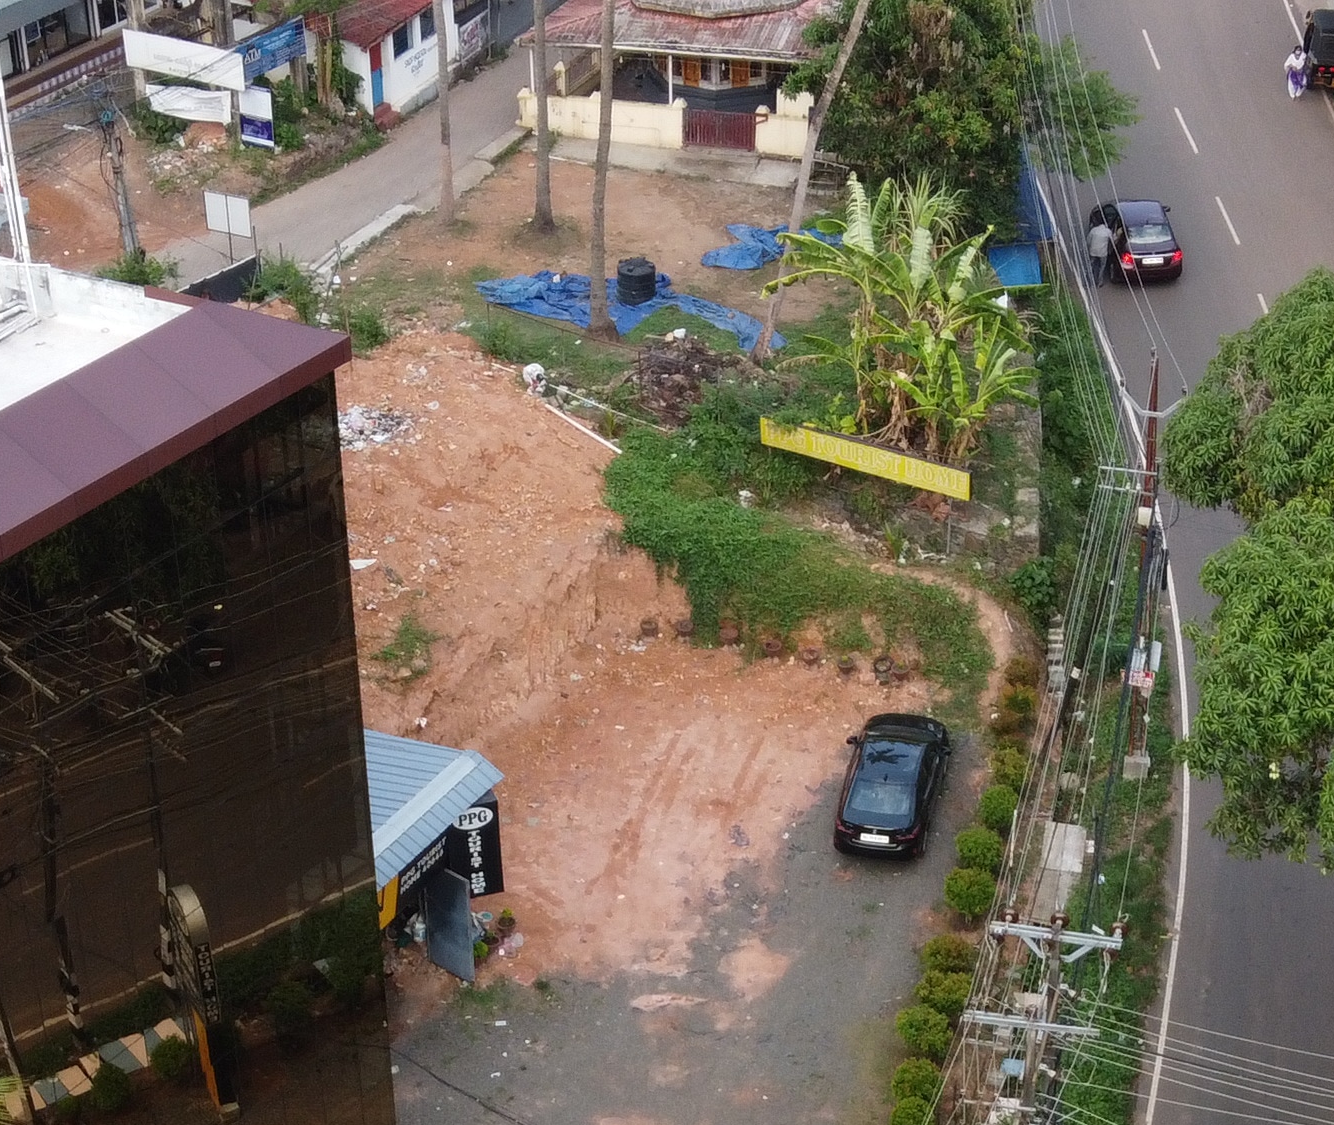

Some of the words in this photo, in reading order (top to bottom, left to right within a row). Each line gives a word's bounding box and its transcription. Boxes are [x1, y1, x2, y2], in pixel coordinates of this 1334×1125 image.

[812, 435, 901, 474] TOURIST
[905, 460, 968, 492] HOME
[458, 810, 488, 827] PPG
